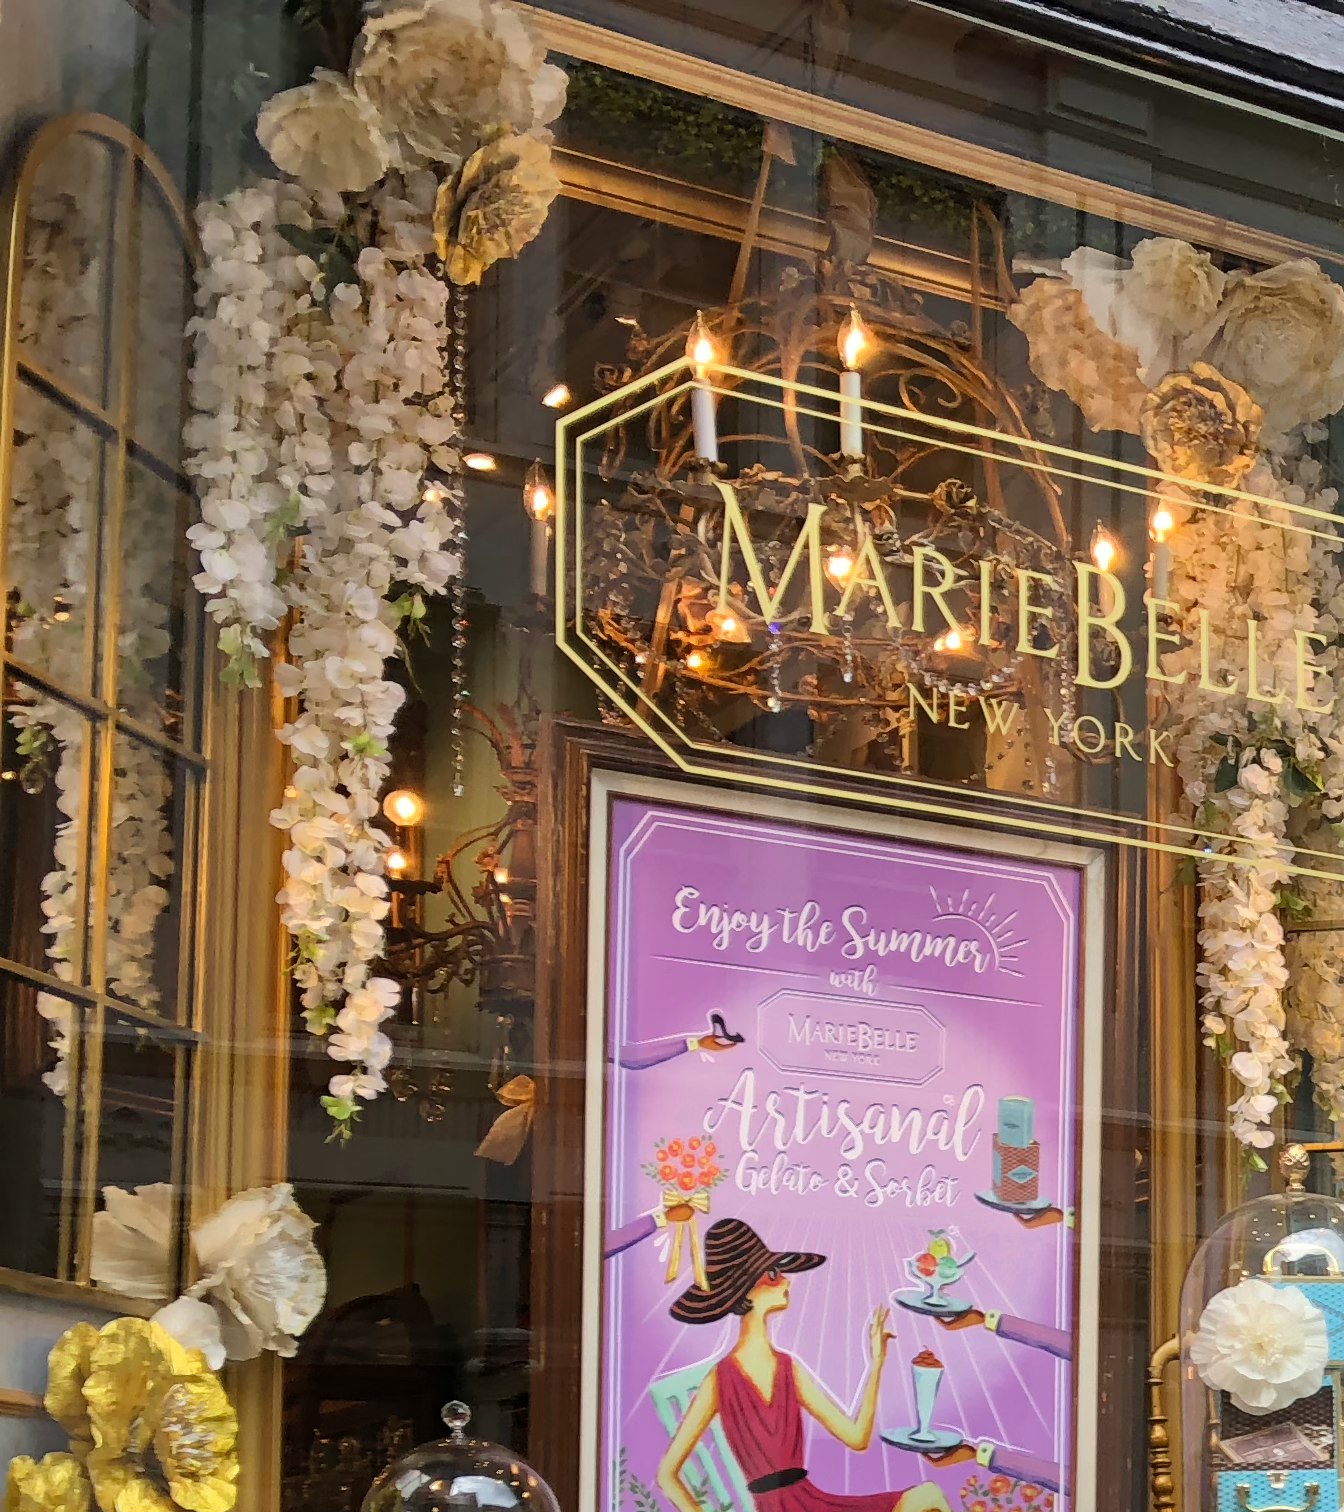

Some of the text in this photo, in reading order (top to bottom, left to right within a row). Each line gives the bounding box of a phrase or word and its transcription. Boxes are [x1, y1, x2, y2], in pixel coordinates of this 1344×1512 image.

[907, 682, 1176, 768] NEW YORK
[672, 885, 990, 973] Enjoy the Summer
[830, 963, 879, 997] with
[824, 1049, 881, 1066] NEW YORK
[703, 1068, 985, 1161] Artisanal
[735, 1150, 960, 1208] Gelato & Sorbet
